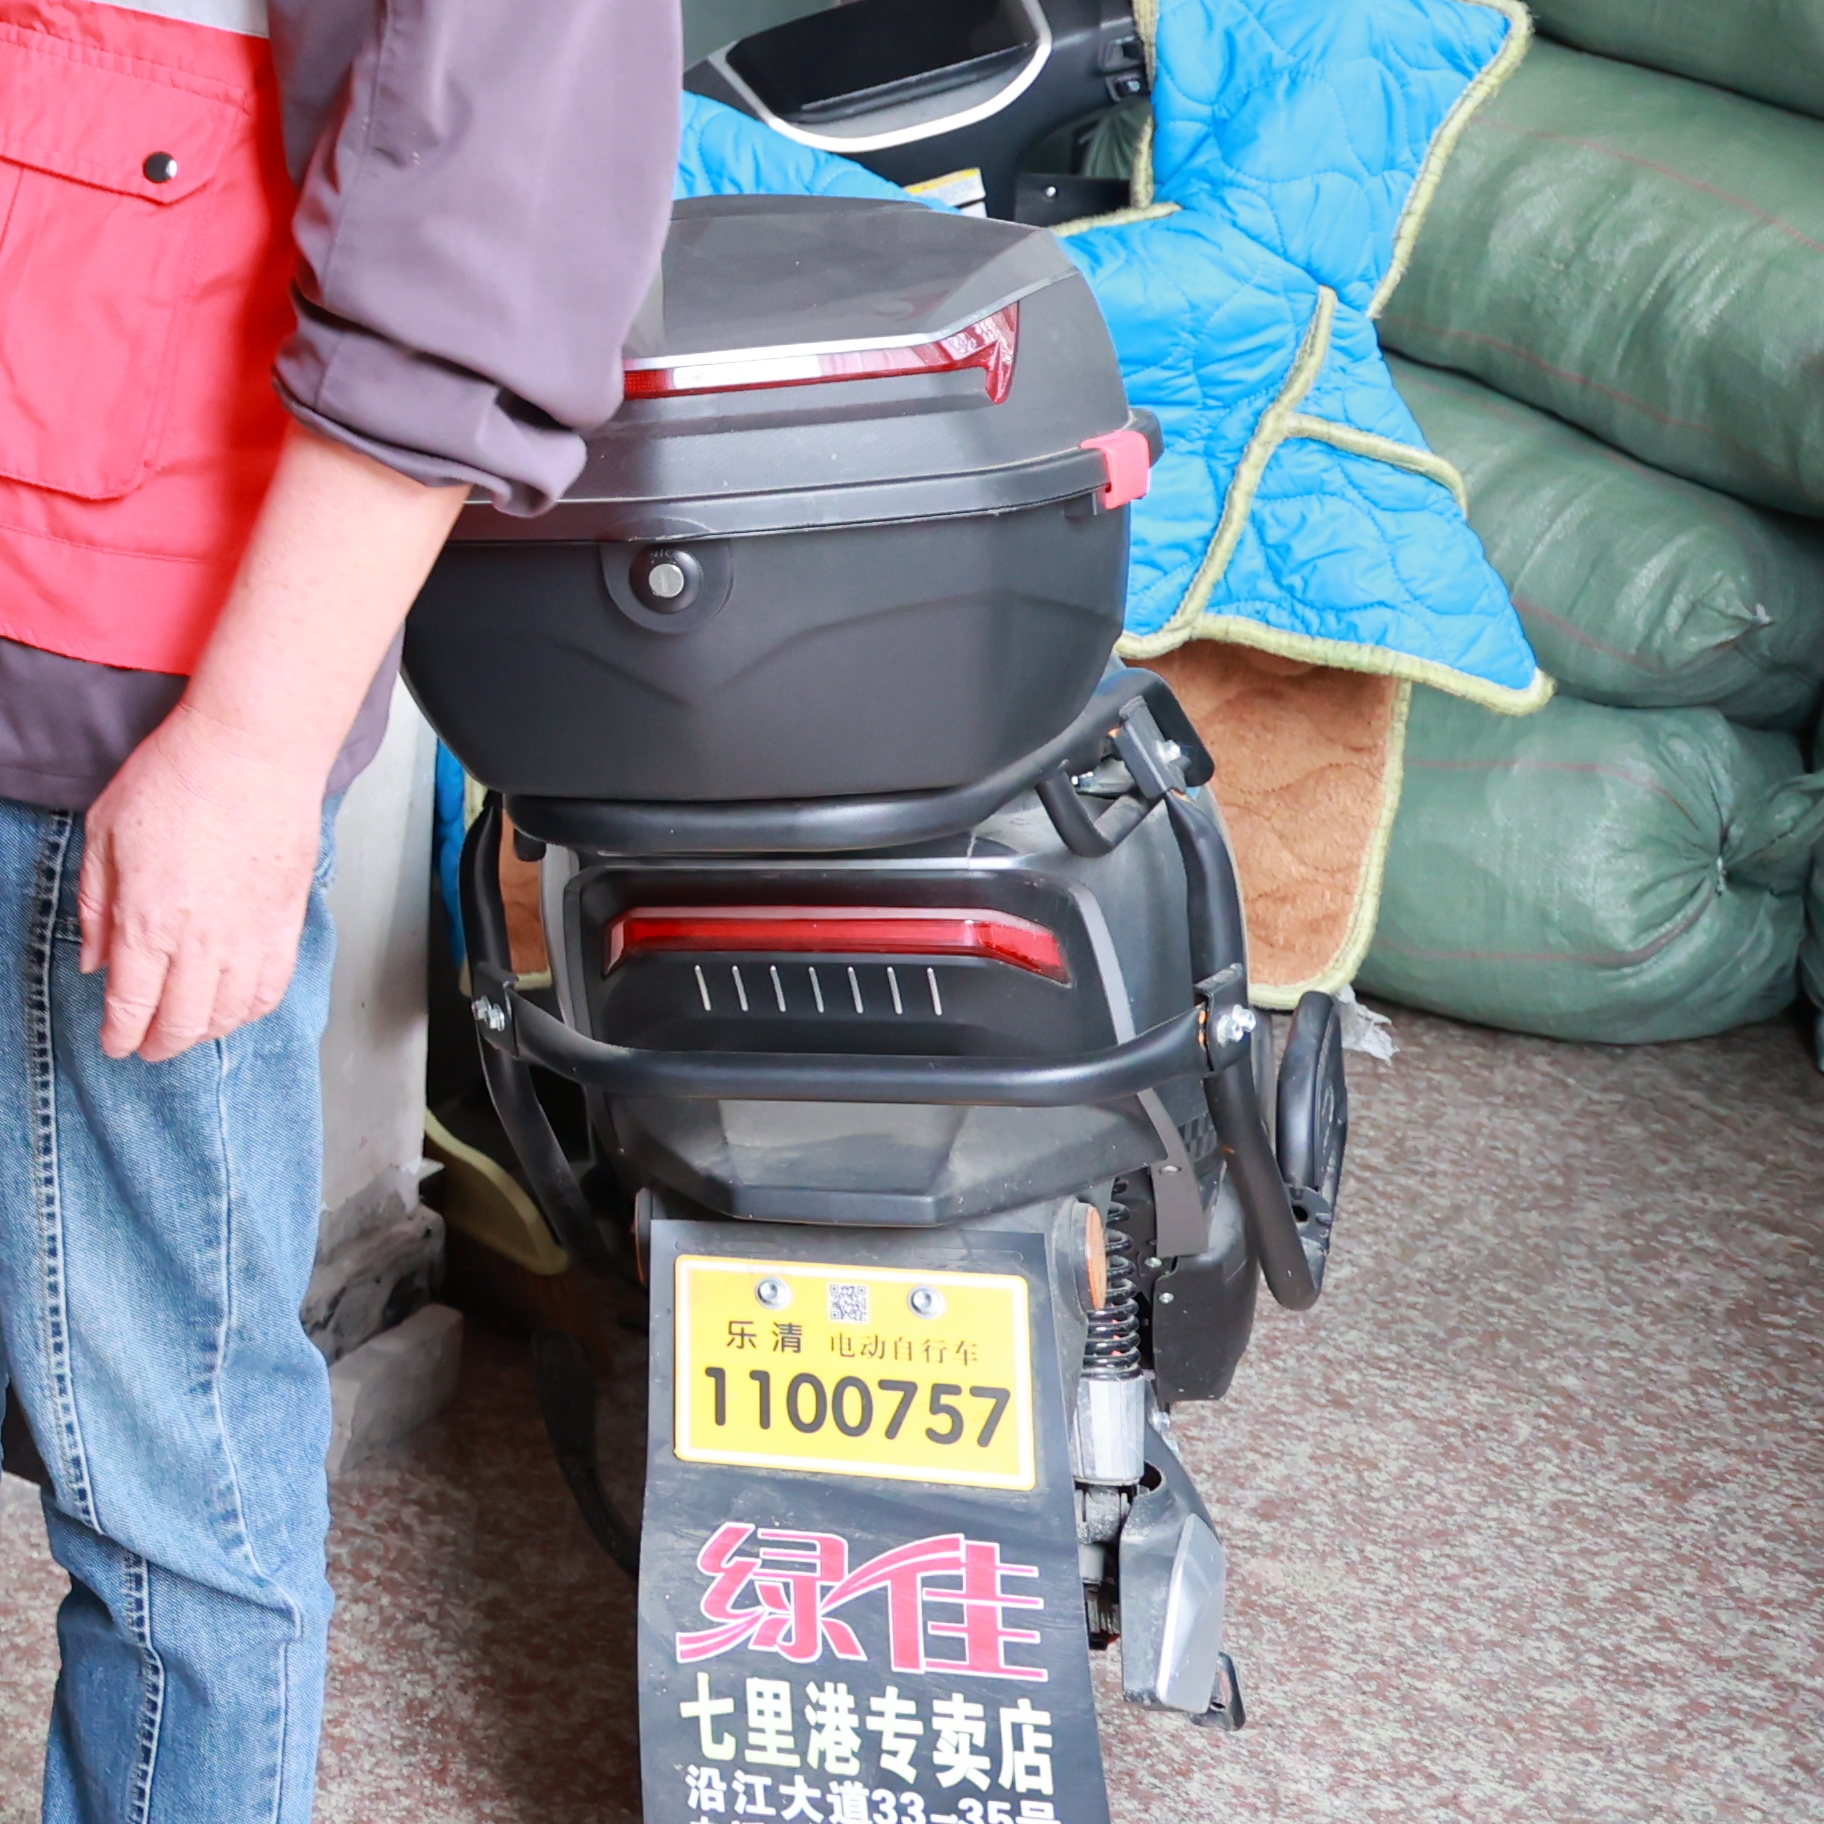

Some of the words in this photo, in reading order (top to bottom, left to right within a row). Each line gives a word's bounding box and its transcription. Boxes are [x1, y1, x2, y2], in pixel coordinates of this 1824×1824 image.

[726, 1319, 804, 1354] 乐清
[829, 1331, 979, 1367] 电动自行车
[704, 1366, 1012, 1449] 1100757
[675, 1520, 1049, 1682] 绿佳
[678, 1671, 1054, 1795] 七里港专卖店
